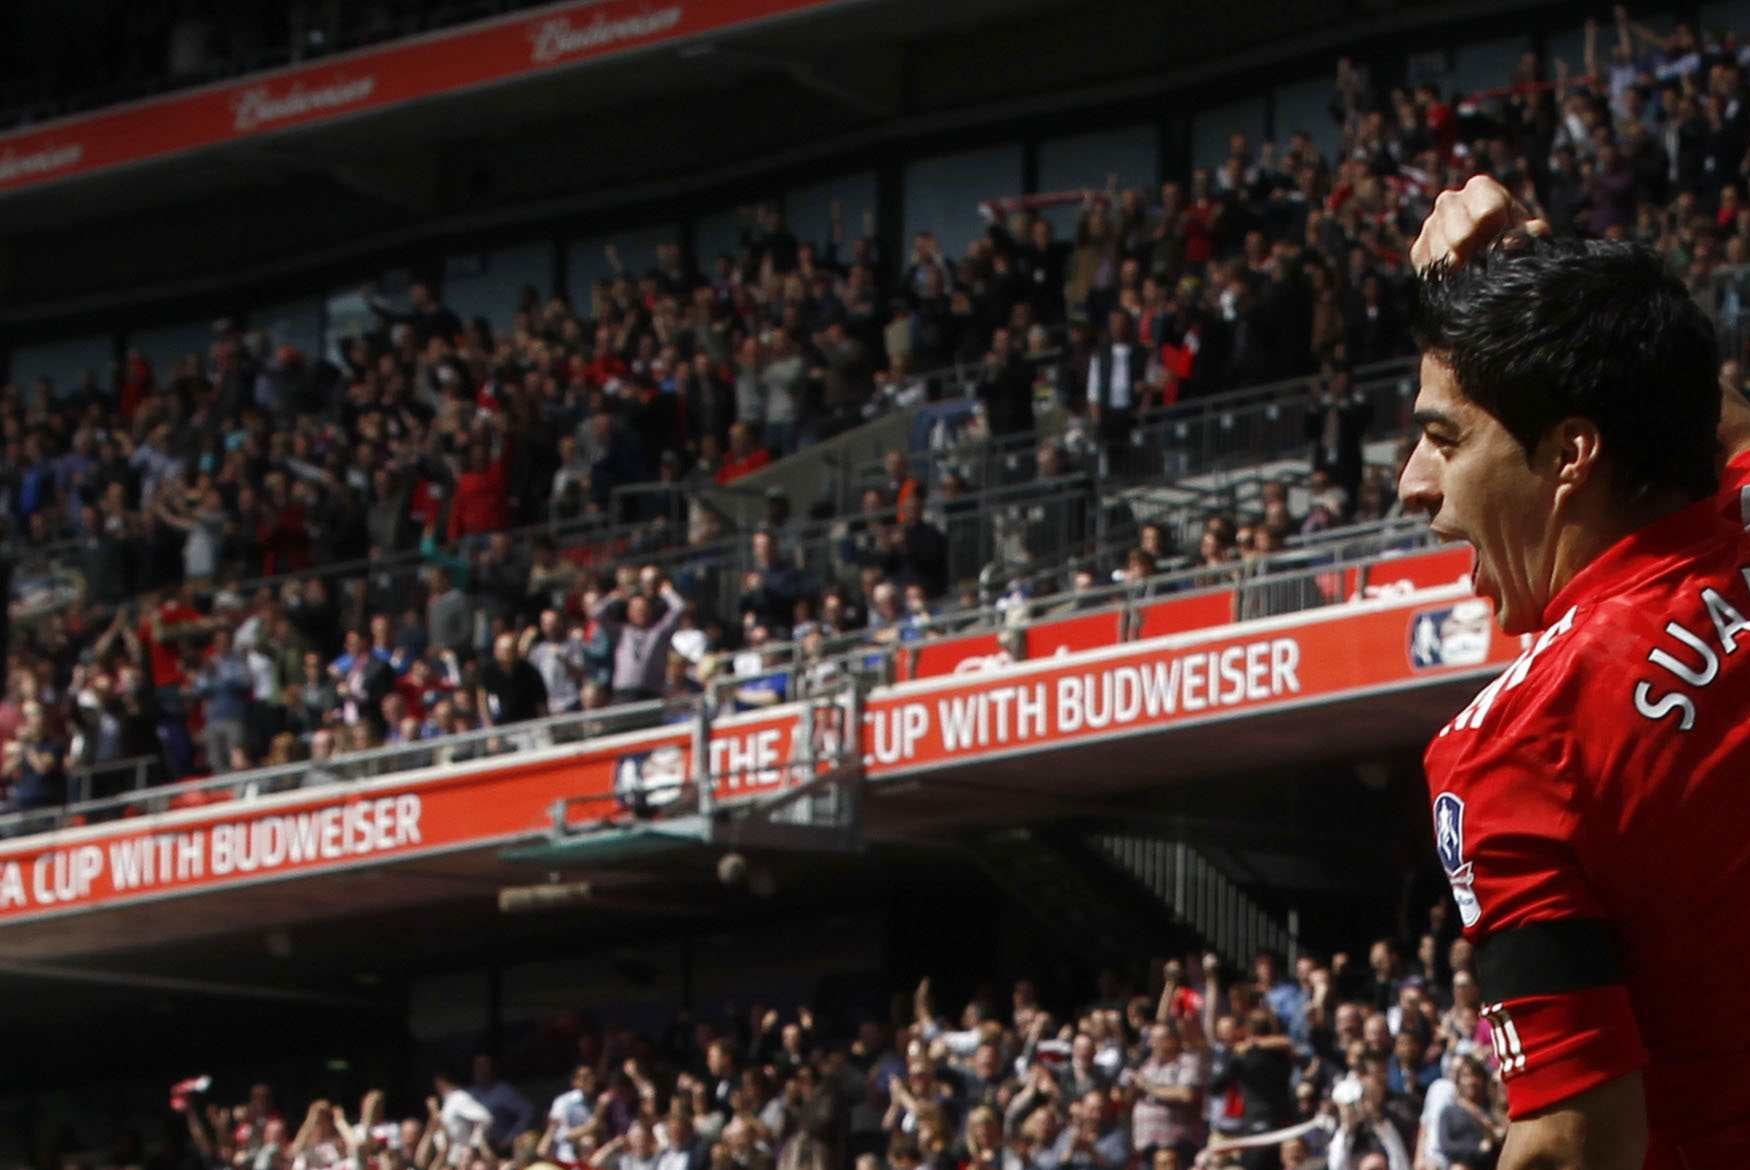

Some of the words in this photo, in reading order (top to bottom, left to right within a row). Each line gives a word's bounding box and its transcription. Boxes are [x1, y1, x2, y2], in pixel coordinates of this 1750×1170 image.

[710, 729, 782, 788] THE
[938, 684, 1047, 752] WITH
[1057, 637, 1300, 733] BUDWEISER
[0, 861, 27, 907] A
[33, 845, 103, 904] CUP
[109, 831, 204, 891] WITH
[211, 793, 422, 876] BUDWEISER
